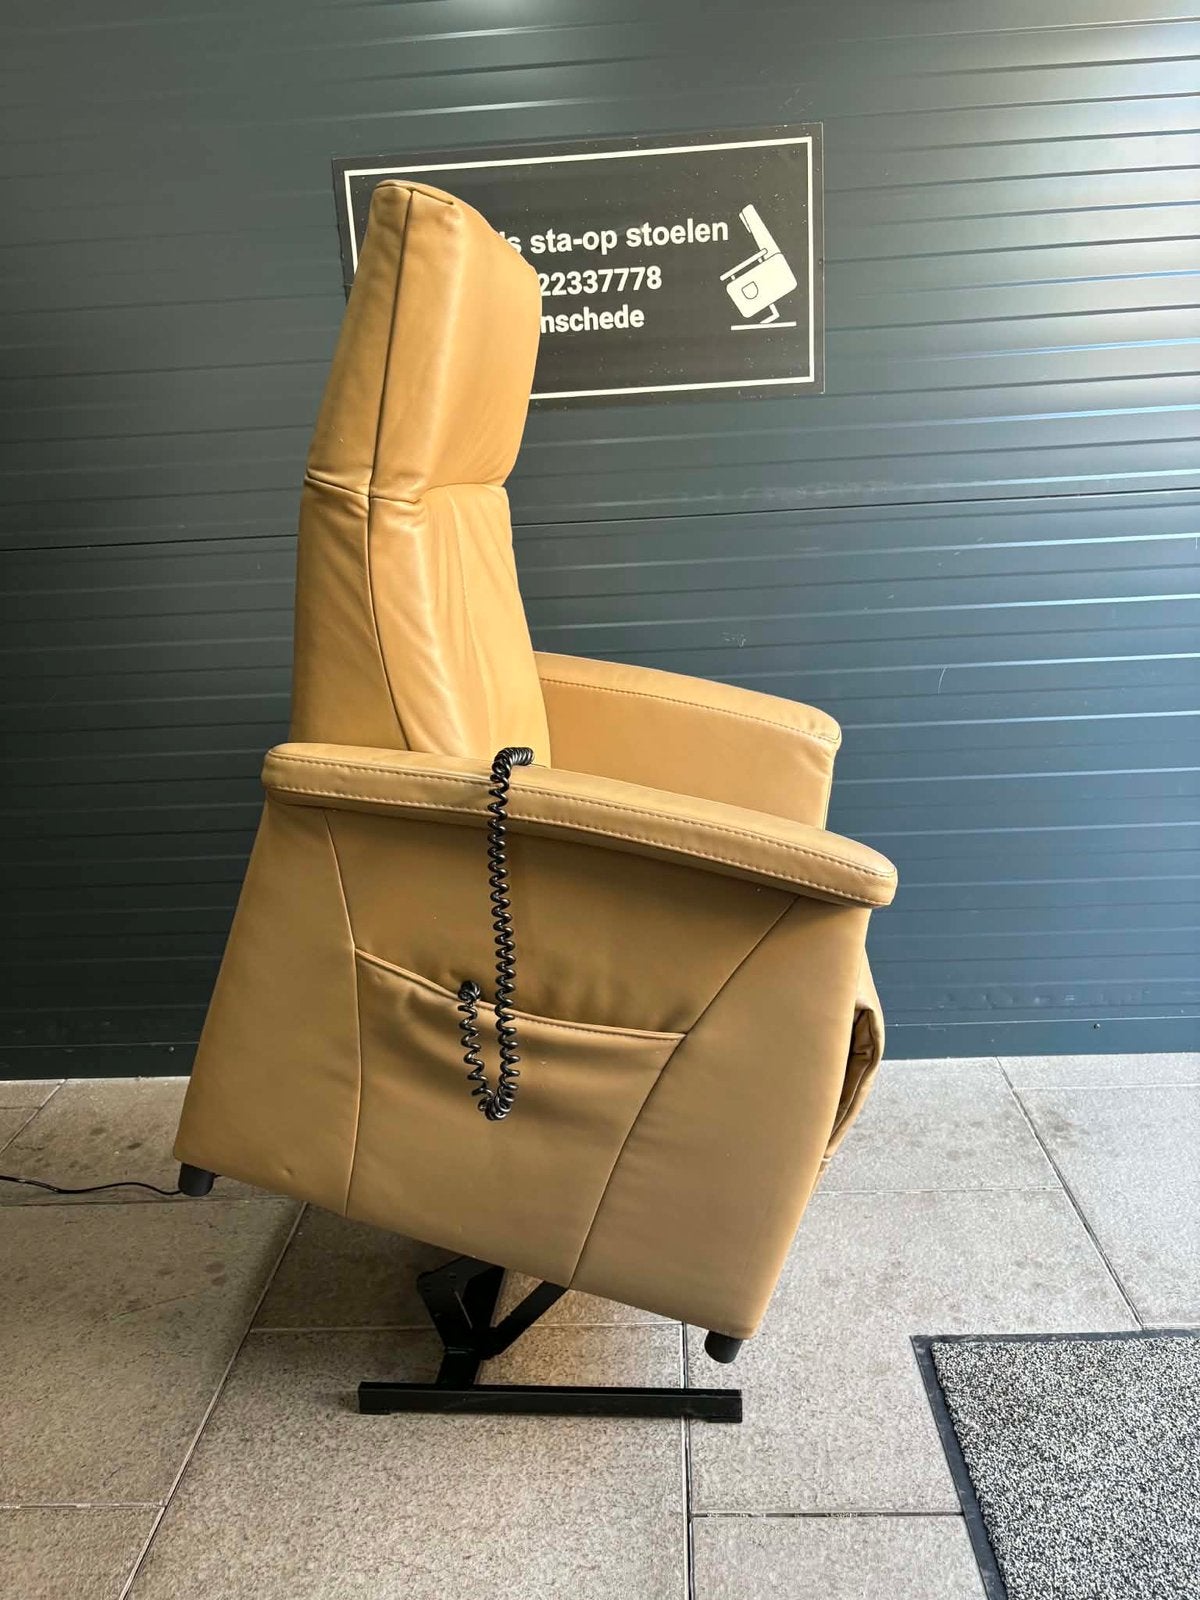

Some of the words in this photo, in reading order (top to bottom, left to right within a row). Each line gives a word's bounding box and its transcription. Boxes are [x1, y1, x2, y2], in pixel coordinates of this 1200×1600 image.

[530, 228, 618, 256] sta-op
[626, 217, 729, 248] stoelen
[537, 266, 662, 296] 22337778
[540, 304, 645, 333] nschede
